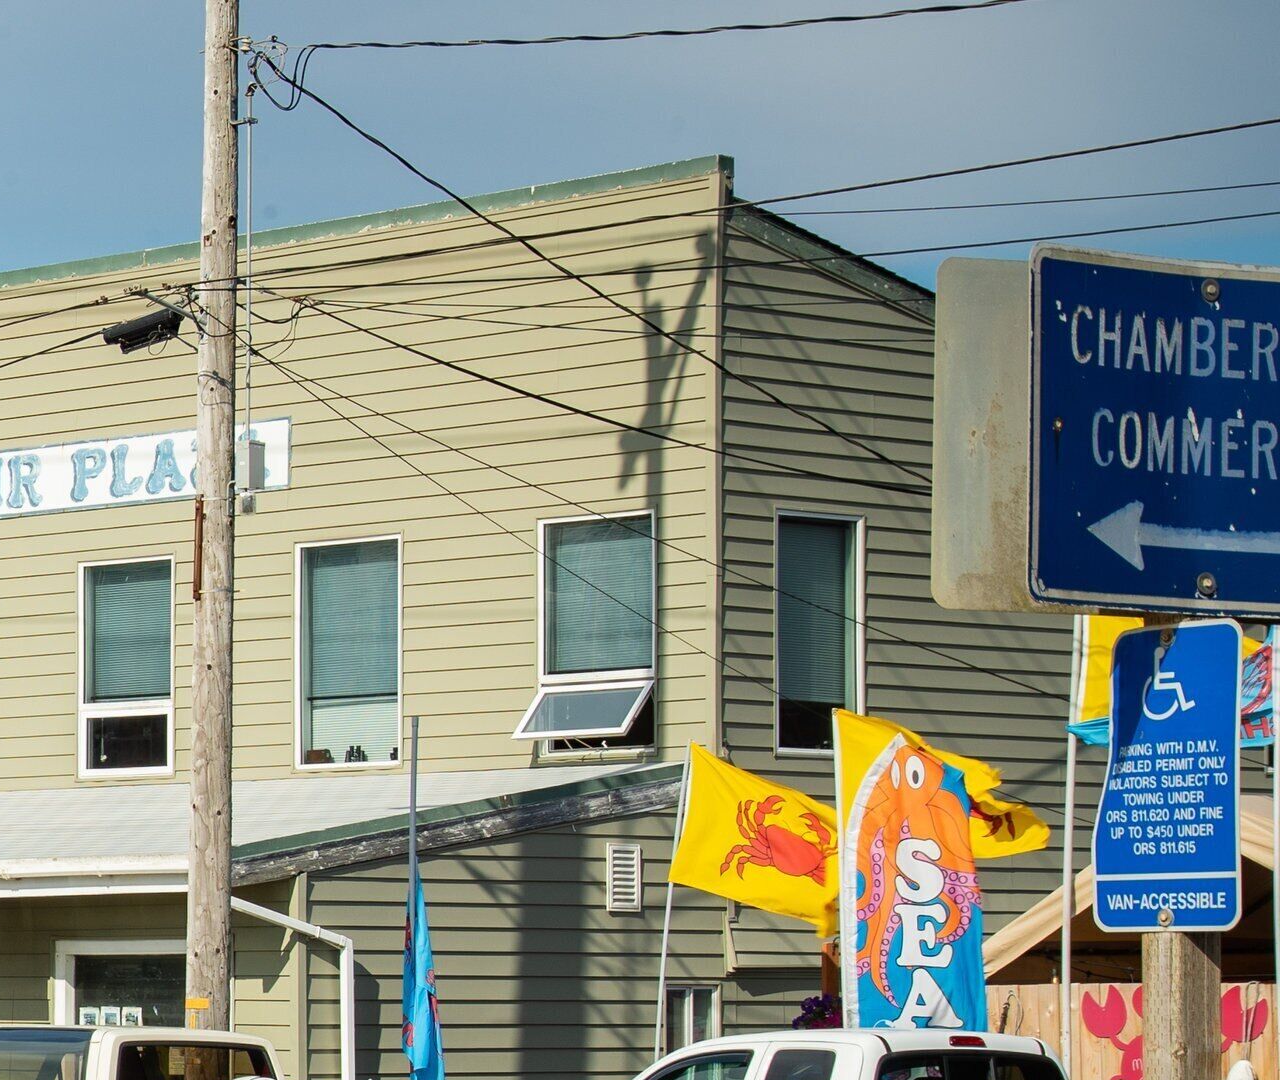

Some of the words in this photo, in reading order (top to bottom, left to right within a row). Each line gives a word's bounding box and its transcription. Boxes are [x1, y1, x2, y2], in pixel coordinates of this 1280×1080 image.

[1071, 304, 1280, 381] CHAMBER
[1092, 408, 1280, 480] COMMER
[72, 429, 270, 502] PLA
[1119, 743, 1152, 757] PARKING
[1156, 741, 1183, 755] WITH
[1187, 740, 1219, 754] D.M.V.
[1112, 759, 1151, 775] DISABLED
[1155, 757, 1194, 772] PERMIT
[1198, 756, 1226, 770] ONLY
[1109, 776, 1157, 791] VIOLATORS
[1161, 773, 1208, 788] SUBJECT
[1213, 772, 1228, 786] TO
[1123, 793, 1163, 806] TOWING
[1168, 791, 1204, 804] UNDER
[1106, 811, 1127, 823] ORS
[1131, 809, 1169, 822] 811.620
[1173, 808, 1195, 821] AND
[1199, 806, 1223, 819] FINE
[1110, 827, 1124, 839] UP
[1128, 826, 1142, 839] TO
[1146, 825, 1173, 838] $450
[1177, 824, 1214, 837] UNDER
[1133, 842, 1156, 855] ORS
[1160, 841, 1196, 854] 811.615
[1107, 892, 1226, 910] VAN-ACCESSIBLE
[893, 838, 963, 1029] SEA
